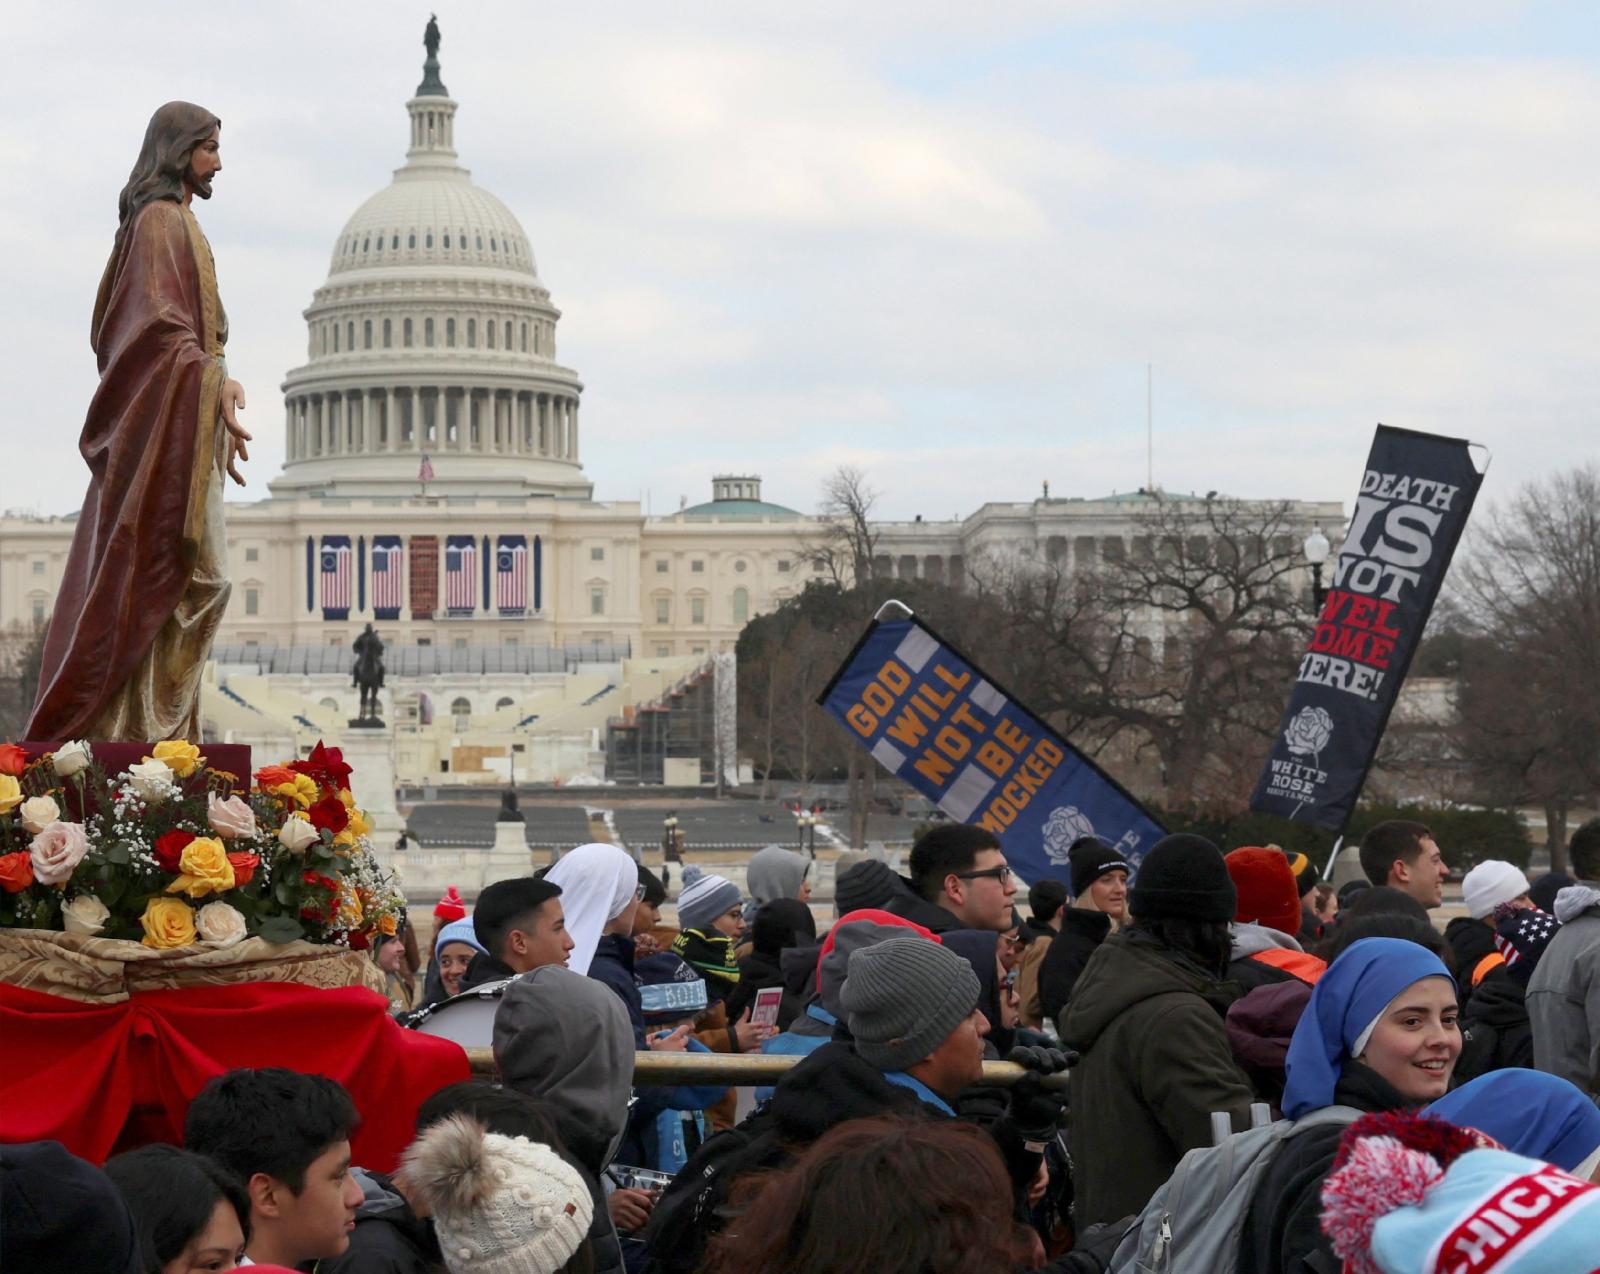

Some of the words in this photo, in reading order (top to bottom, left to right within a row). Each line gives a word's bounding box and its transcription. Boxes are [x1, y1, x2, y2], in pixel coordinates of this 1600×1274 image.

[1359, 469, 1460, 511] DEATH
[1340, 495, 1443, 567] IS
[1307, 623, 1395, 670] OME
[845, 660, 912, 737] GOD
[886, 664, 970, 748] WILL
[914, 703, 986, 786] NOT
[975, 718, 1031, 778] BE
[1271, 759, 1328, 784] WHITE
[975, 738, 1064, 833] MOCKED
[1271, 774, 1315, 795] ROSE
[1453, 1167, 1585, 1274] HICA
